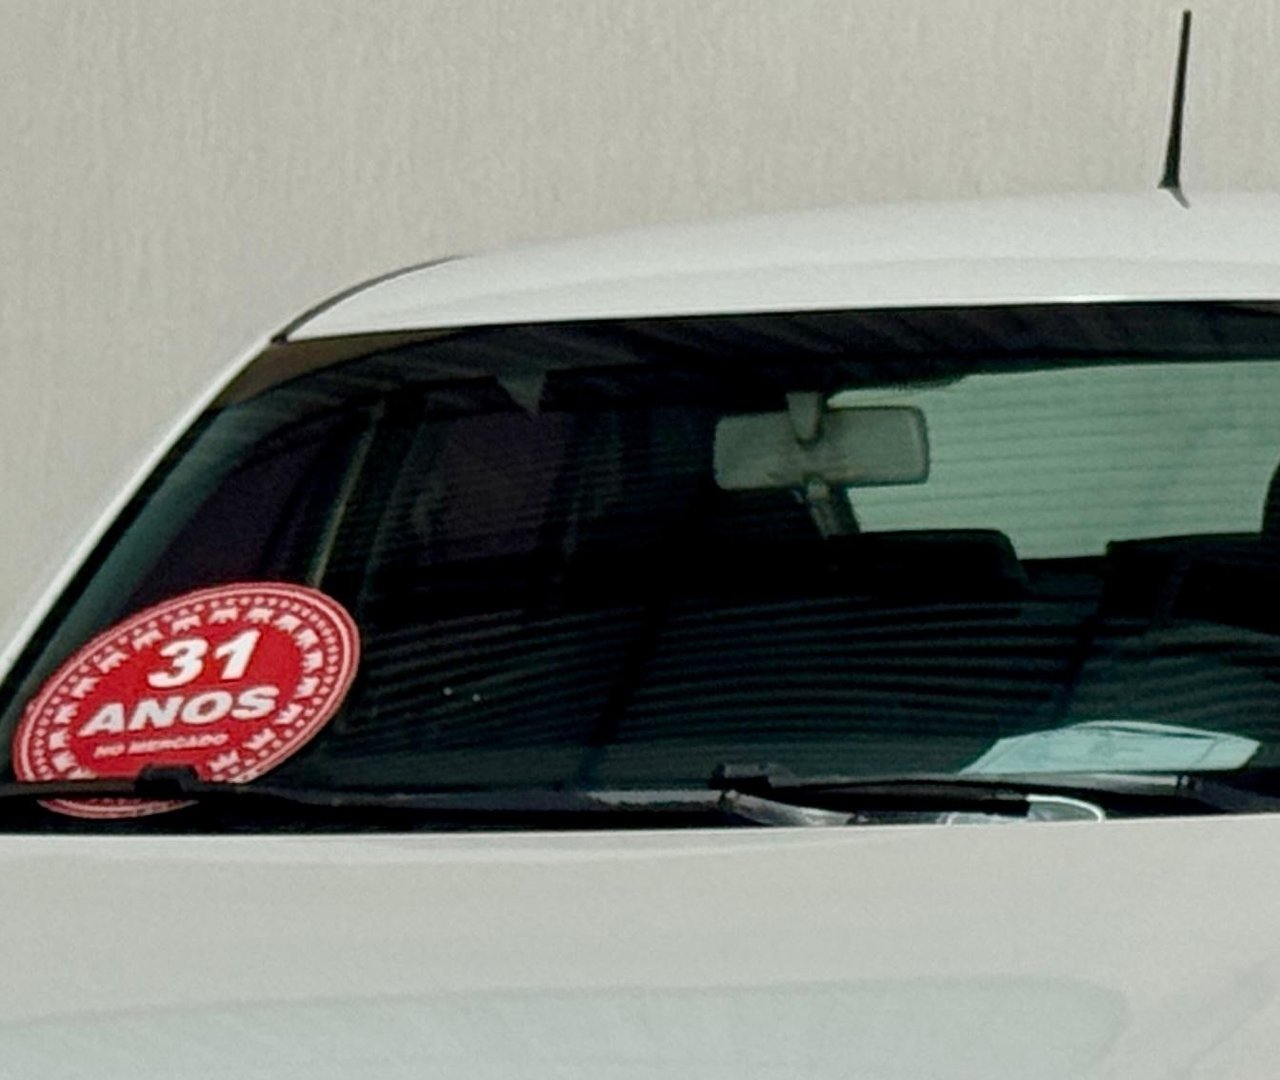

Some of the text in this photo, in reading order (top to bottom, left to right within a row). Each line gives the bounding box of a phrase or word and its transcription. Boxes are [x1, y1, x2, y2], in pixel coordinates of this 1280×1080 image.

[147, 627, 262, 689] 31
[76, 685, 280, 738] ANOS
[93, 743, 126, 759] NO
